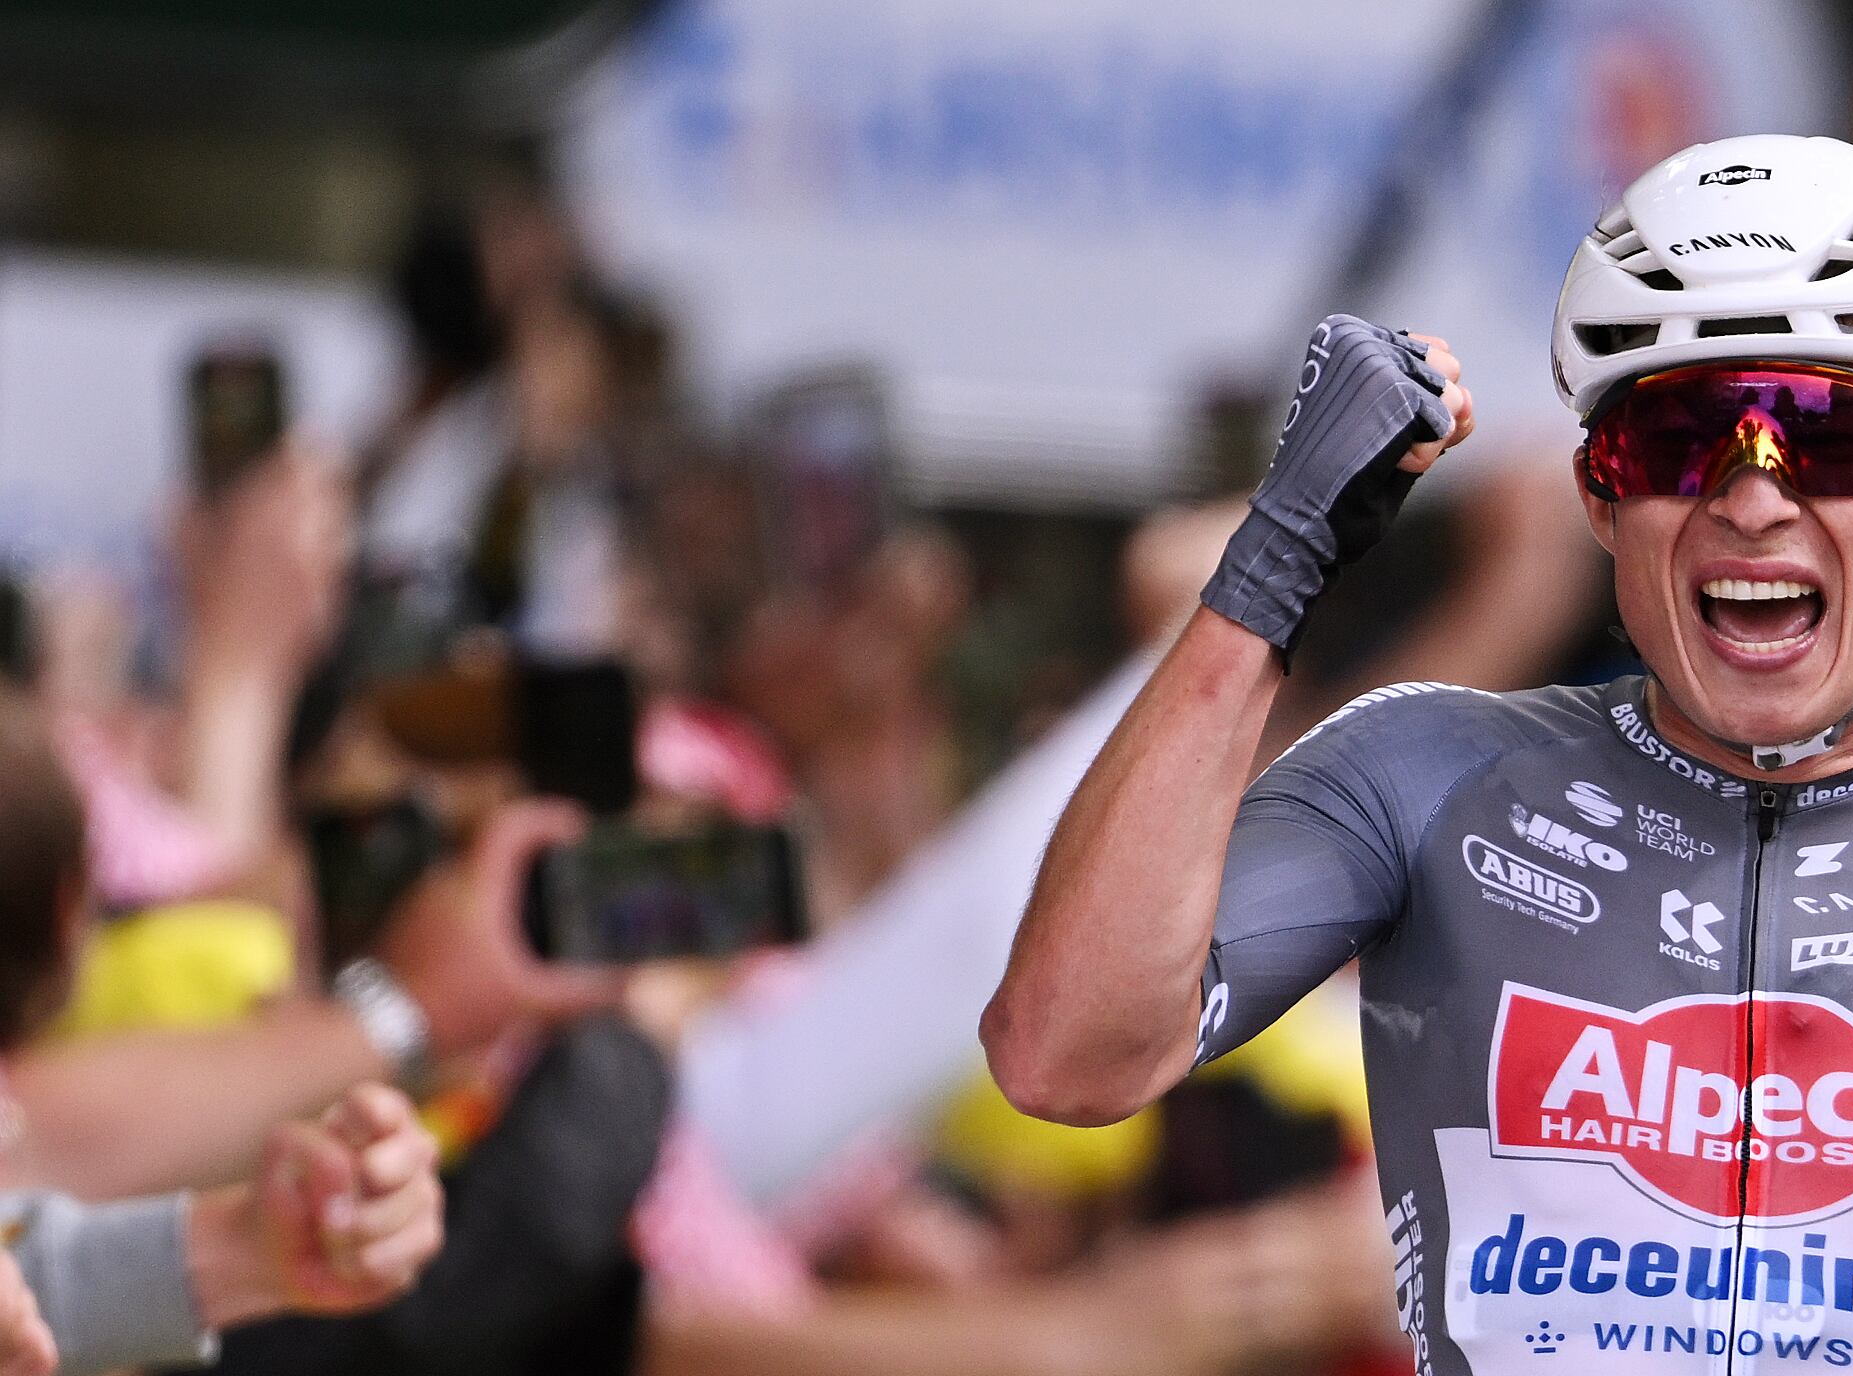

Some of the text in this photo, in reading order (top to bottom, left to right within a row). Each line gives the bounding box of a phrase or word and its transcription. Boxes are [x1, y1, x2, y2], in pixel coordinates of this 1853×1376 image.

[1704, 168, 1767, 184] Alpecin
[1670, 232, 1797, 256] CANYON
[1610, 702, 1716, 791] BRUSTOR
[1637, 803, 1681, 831] UCI
[1526, 835, 1588, 868] ISOLATIE
[1527, 813, 1628, 872] IKO
[1635, 829, 1694, 862] TEAM
[1636, 817, 1716, 856] WORLD
[1480, 849, 1581, 913] ABUS
[1481, 888, 1580, 935] Security Tech Germany
[1541, 1114, 1663, 1152] HAIR
[1593, 1322, 1853, 1367] WINDOWS
